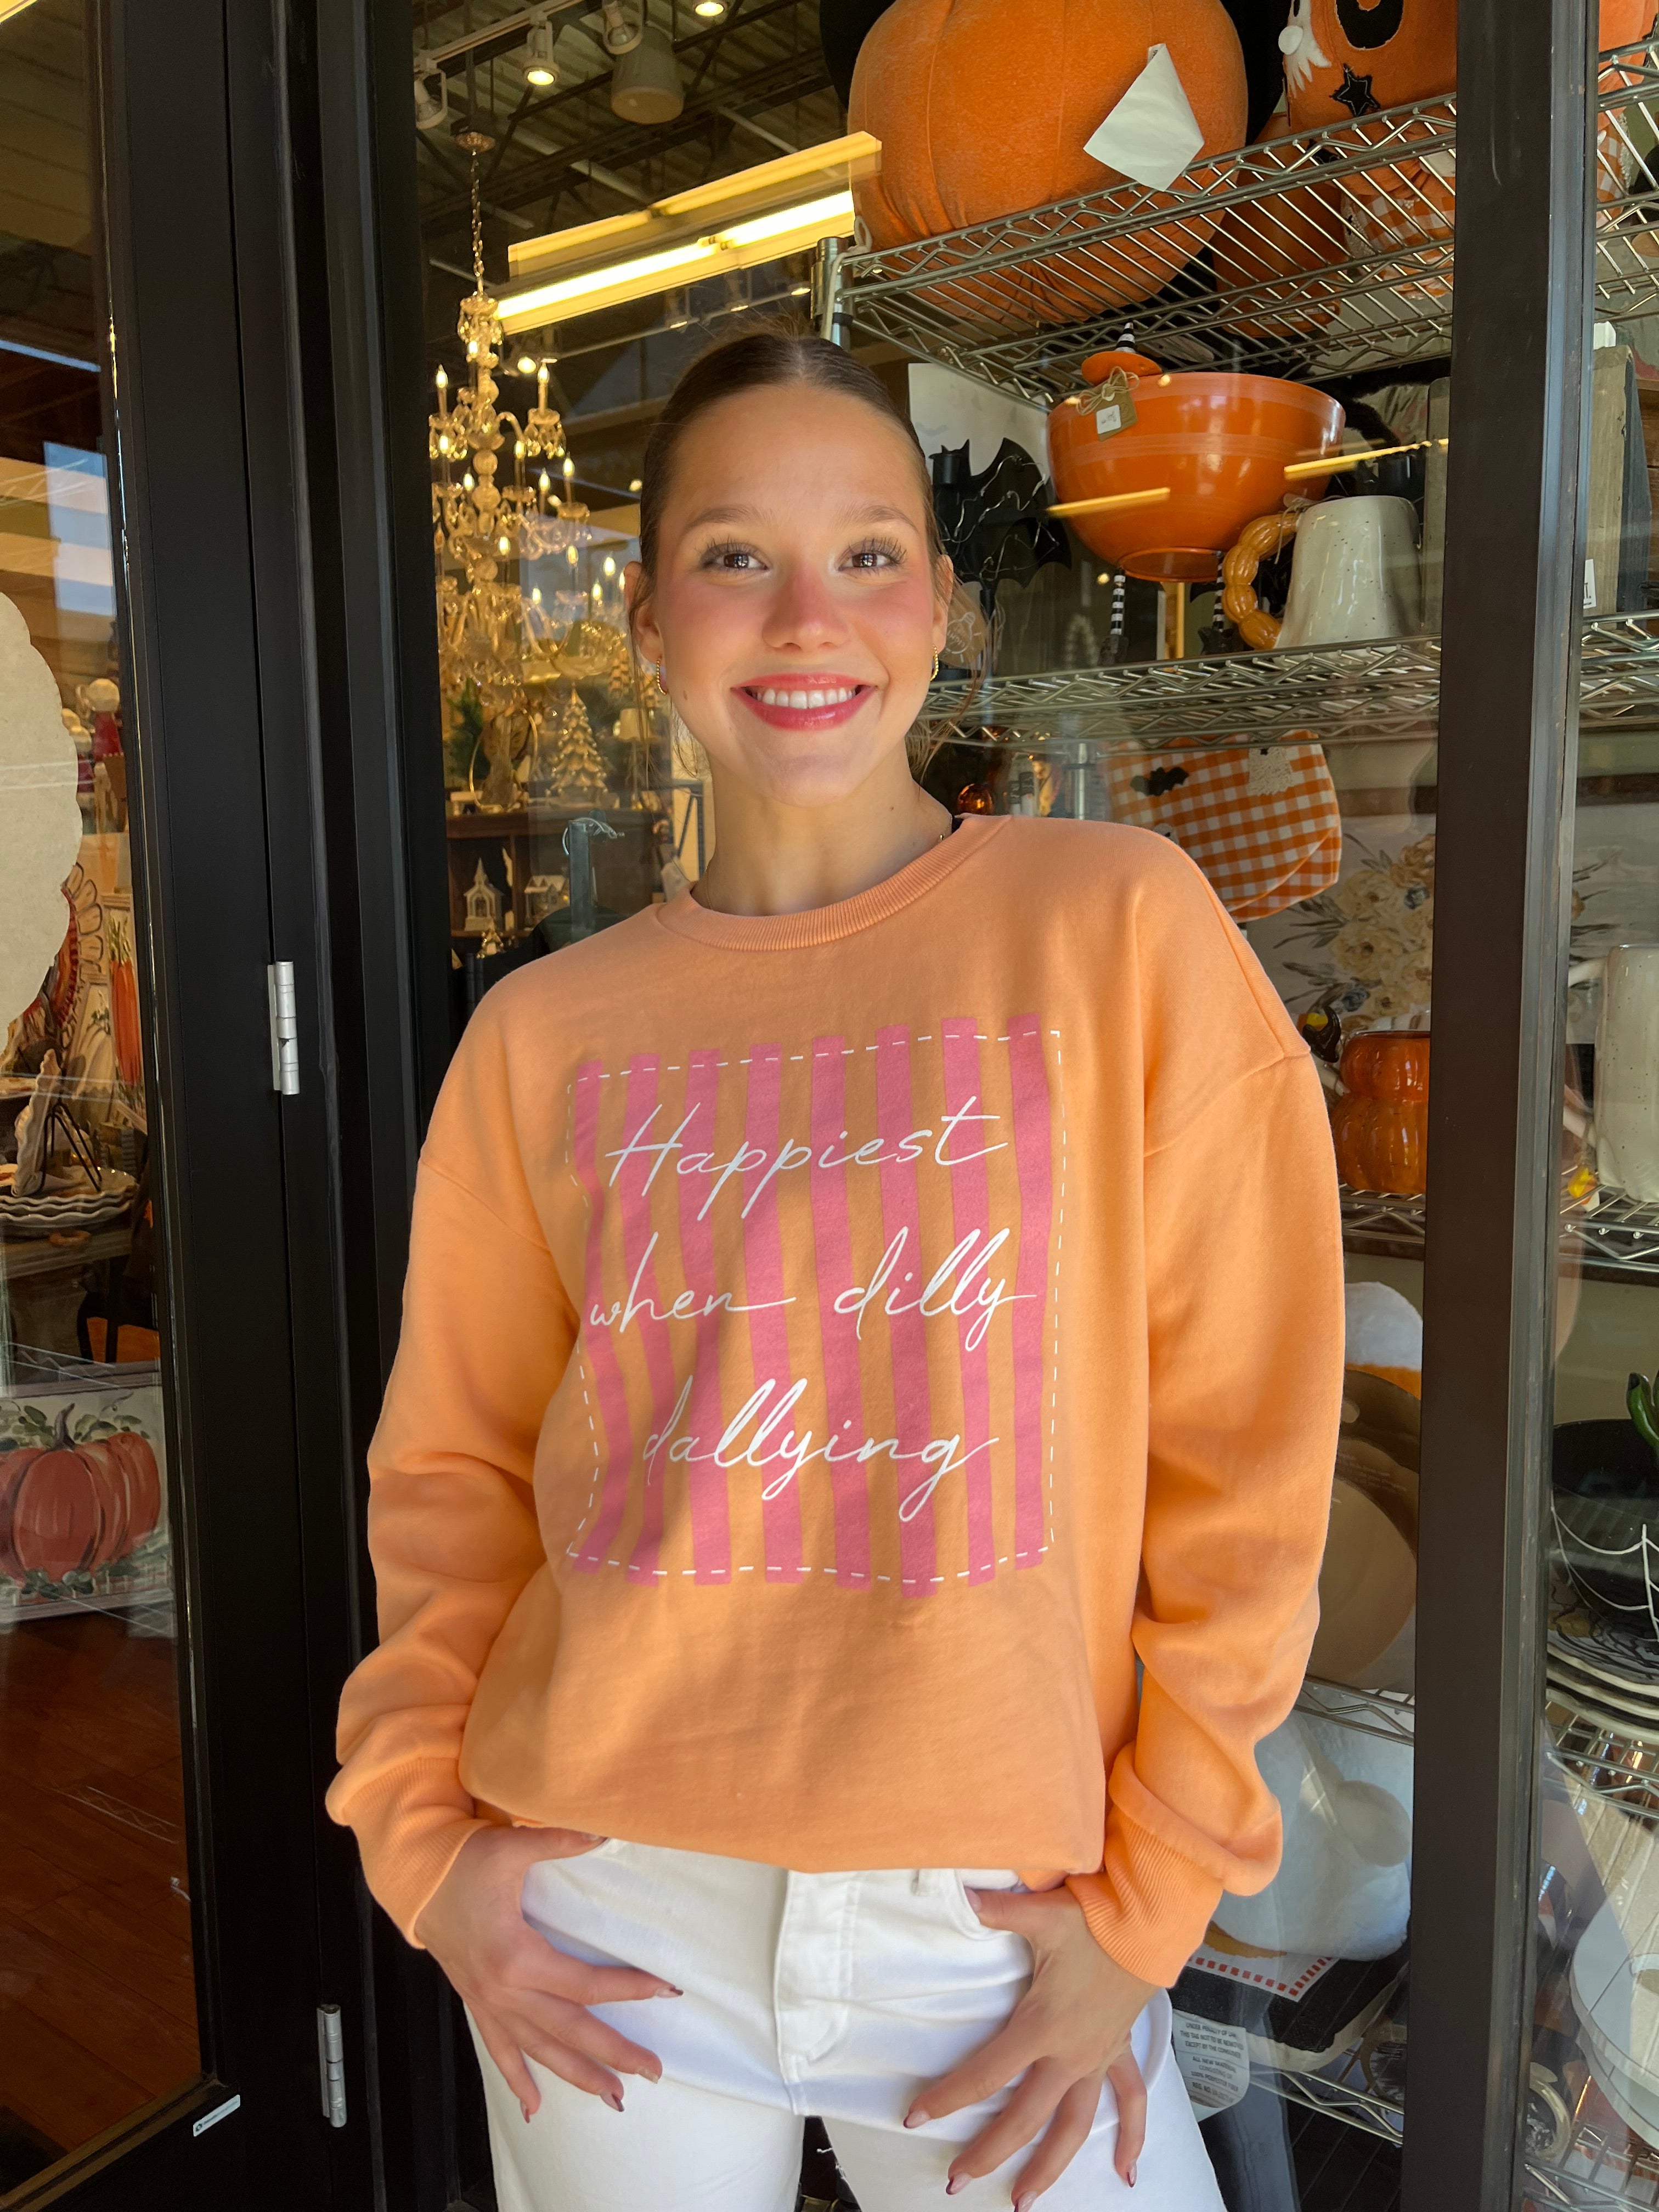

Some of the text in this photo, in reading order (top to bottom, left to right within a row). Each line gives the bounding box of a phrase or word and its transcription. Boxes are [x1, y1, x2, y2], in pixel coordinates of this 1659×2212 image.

[605, 1096, 1008, 1221] Happiest
[590, 1227, 1037, 1352] when dilly
[643, 1376, 1000, 1522] dallying
